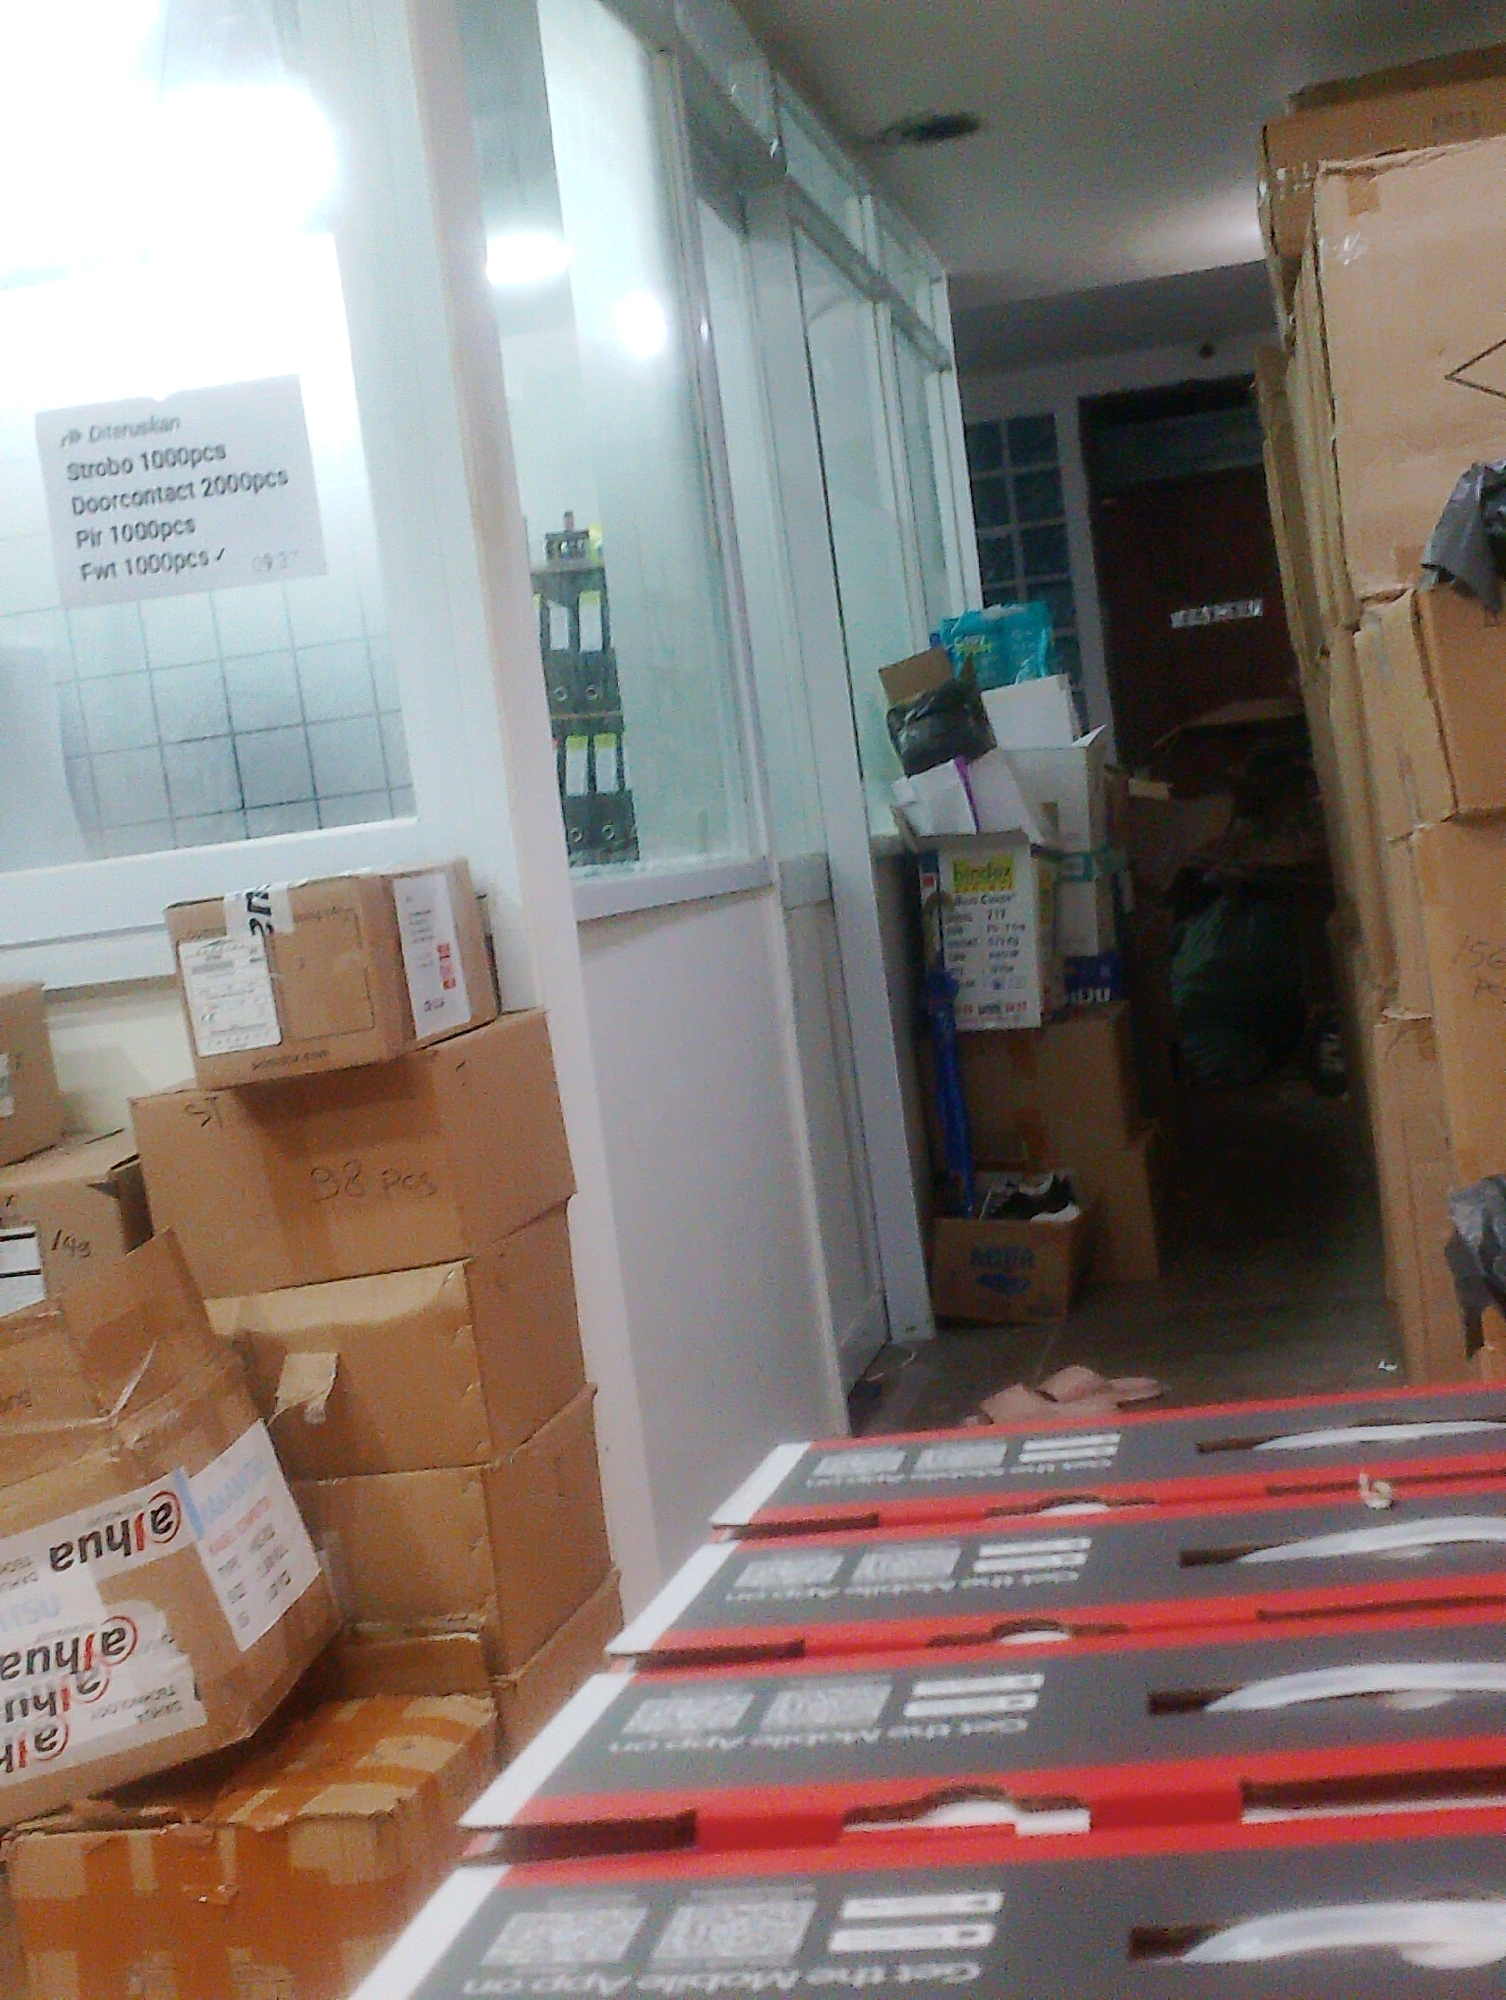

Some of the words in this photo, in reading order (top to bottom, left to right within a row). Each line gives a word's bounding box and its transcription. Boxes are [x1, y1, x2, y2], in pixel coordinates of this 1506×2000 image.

[66, 453, 134, 482] Strobo
[139, 443, 227, 474] 1000pcs
[71, 483, 196, 516] Doorcontact
[200, 467, 290, 500] 2000pcs
[110, 516, 197, 546] 1000pcs
[123, 549, 210, 578] 1000pcs
[636, 1967, 802, 1996] Mobile
[812, 1966, 898, 1989] the
[901, 1961, 981, 1985] Get
